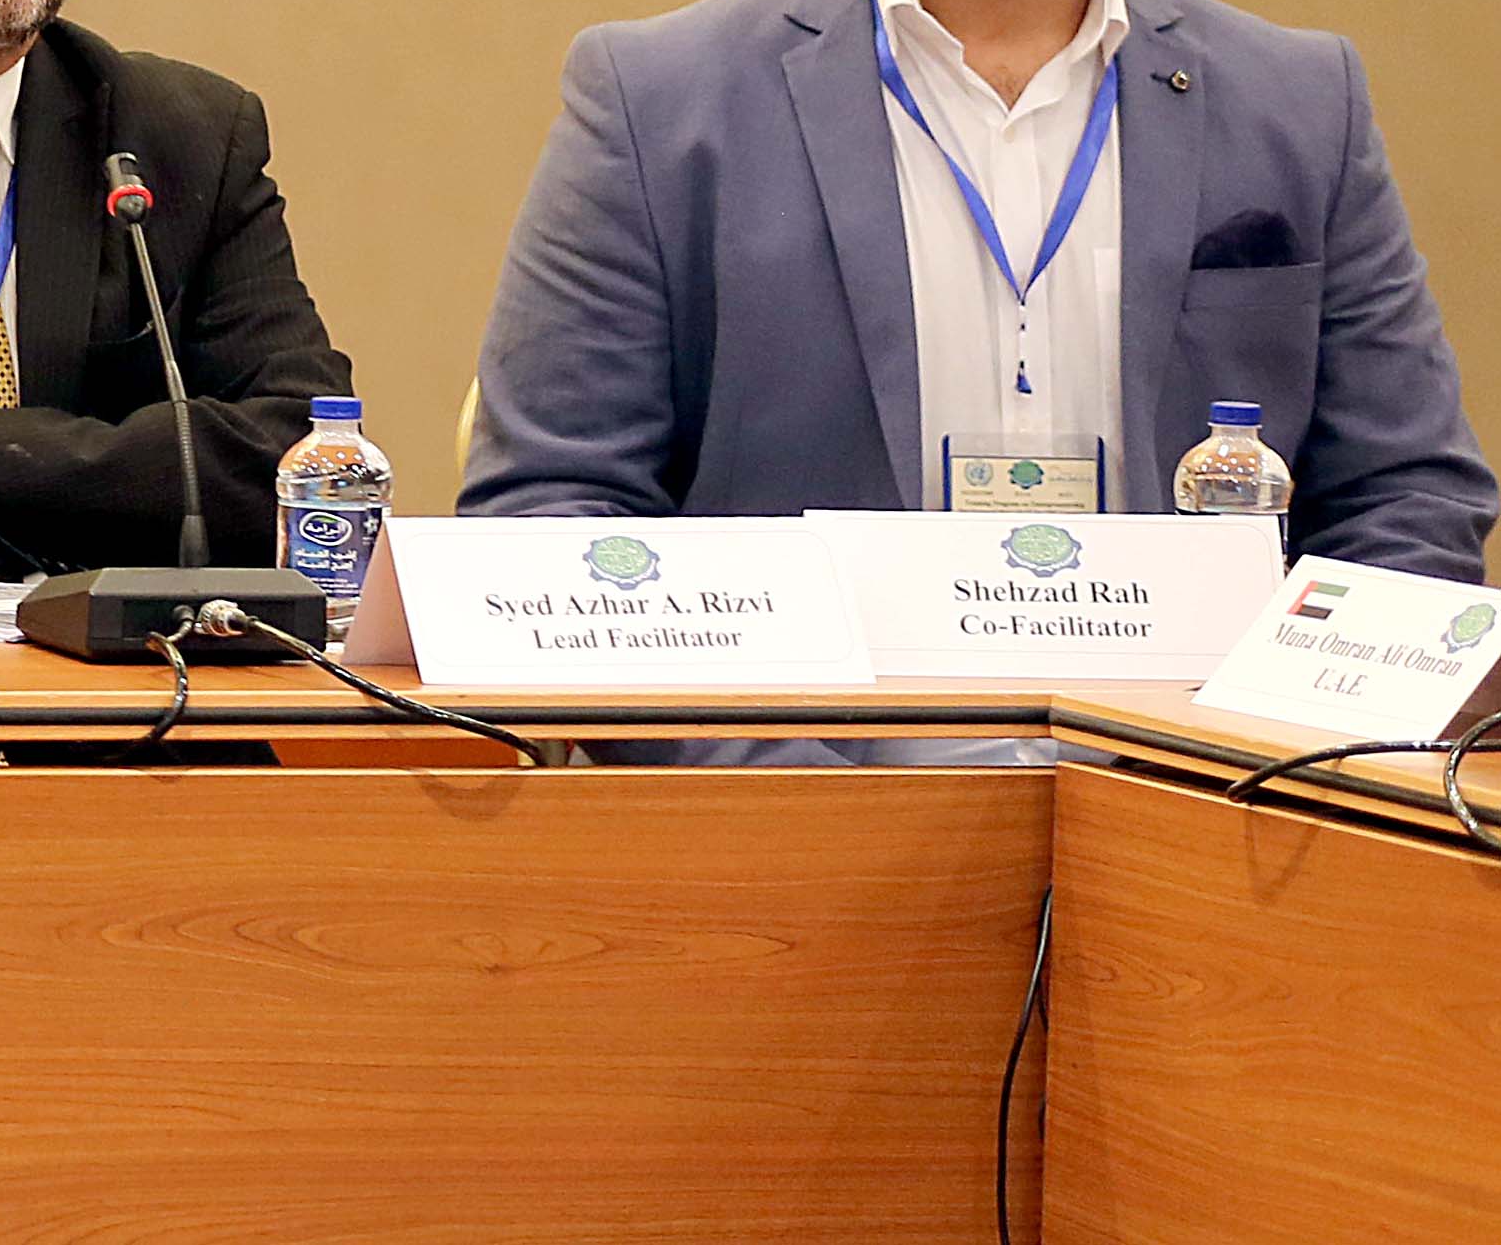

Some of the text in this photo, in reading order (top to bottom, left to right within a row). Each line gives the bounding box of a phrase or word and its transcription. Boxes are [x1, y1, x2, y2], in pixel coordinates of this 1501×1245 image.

[954, 578, 1150, 604] Shehzad Rah
[485, 591, 774, 622] Syed Azhar A. Rizvi
[533, 628, 742, 649] Lead Facilitator
[960, 614, 1152, 637] Co-Facilitator
[1319, 632, 1375, 661] Omran
[1379, 644, 1406, 666] Ali
[1406, 648, 1463, 677] Omran
